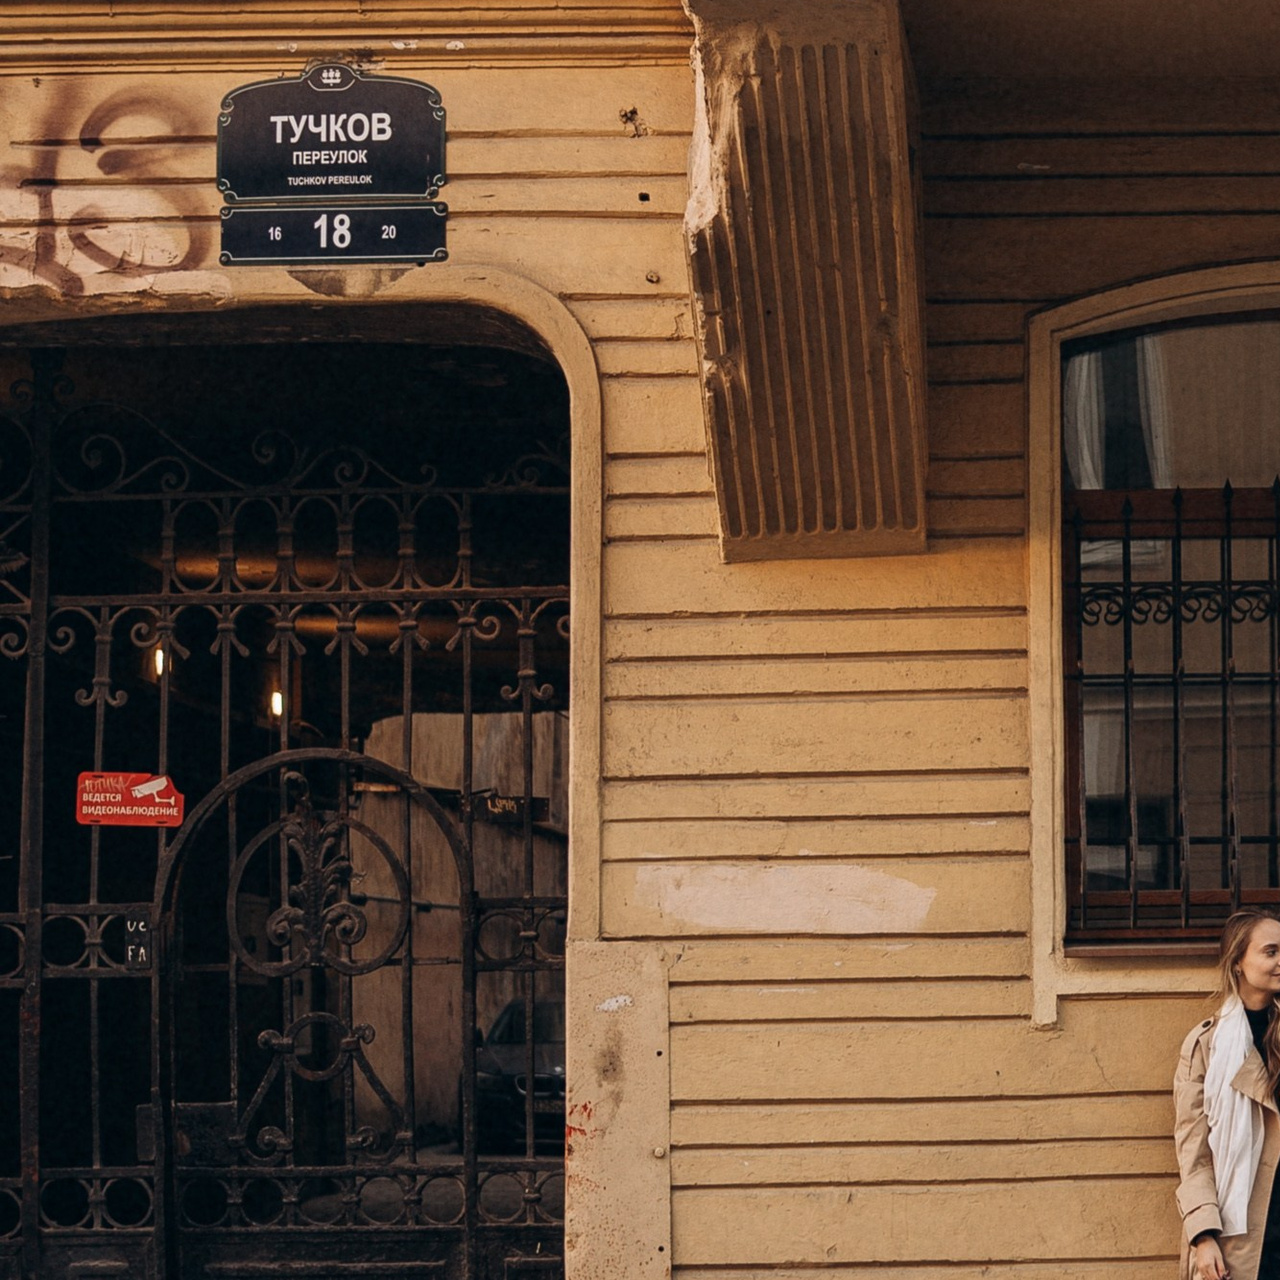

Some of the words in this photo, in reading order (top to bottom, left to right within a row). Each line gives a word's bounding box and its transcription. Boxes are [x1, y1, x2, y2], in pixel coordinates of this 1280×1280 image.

[270, 112, 393, 144] ТУЧКОВ
[292, 149, 368, 166] ПЕРЕУЛОК
[287, 176, 327, 186] TUCHKOV
[328, 174, 373, 185] PEREULOK
[268, 226, 282, 241] 16
[313, 213, 351, 249] 18
[381, 224, 397, 239] 20
[82, 793, 121, 803] ВЕДЕТСЯ
[82, 805, 179, 816] ВИДЕОНАБЛЮДЕНИЕ
